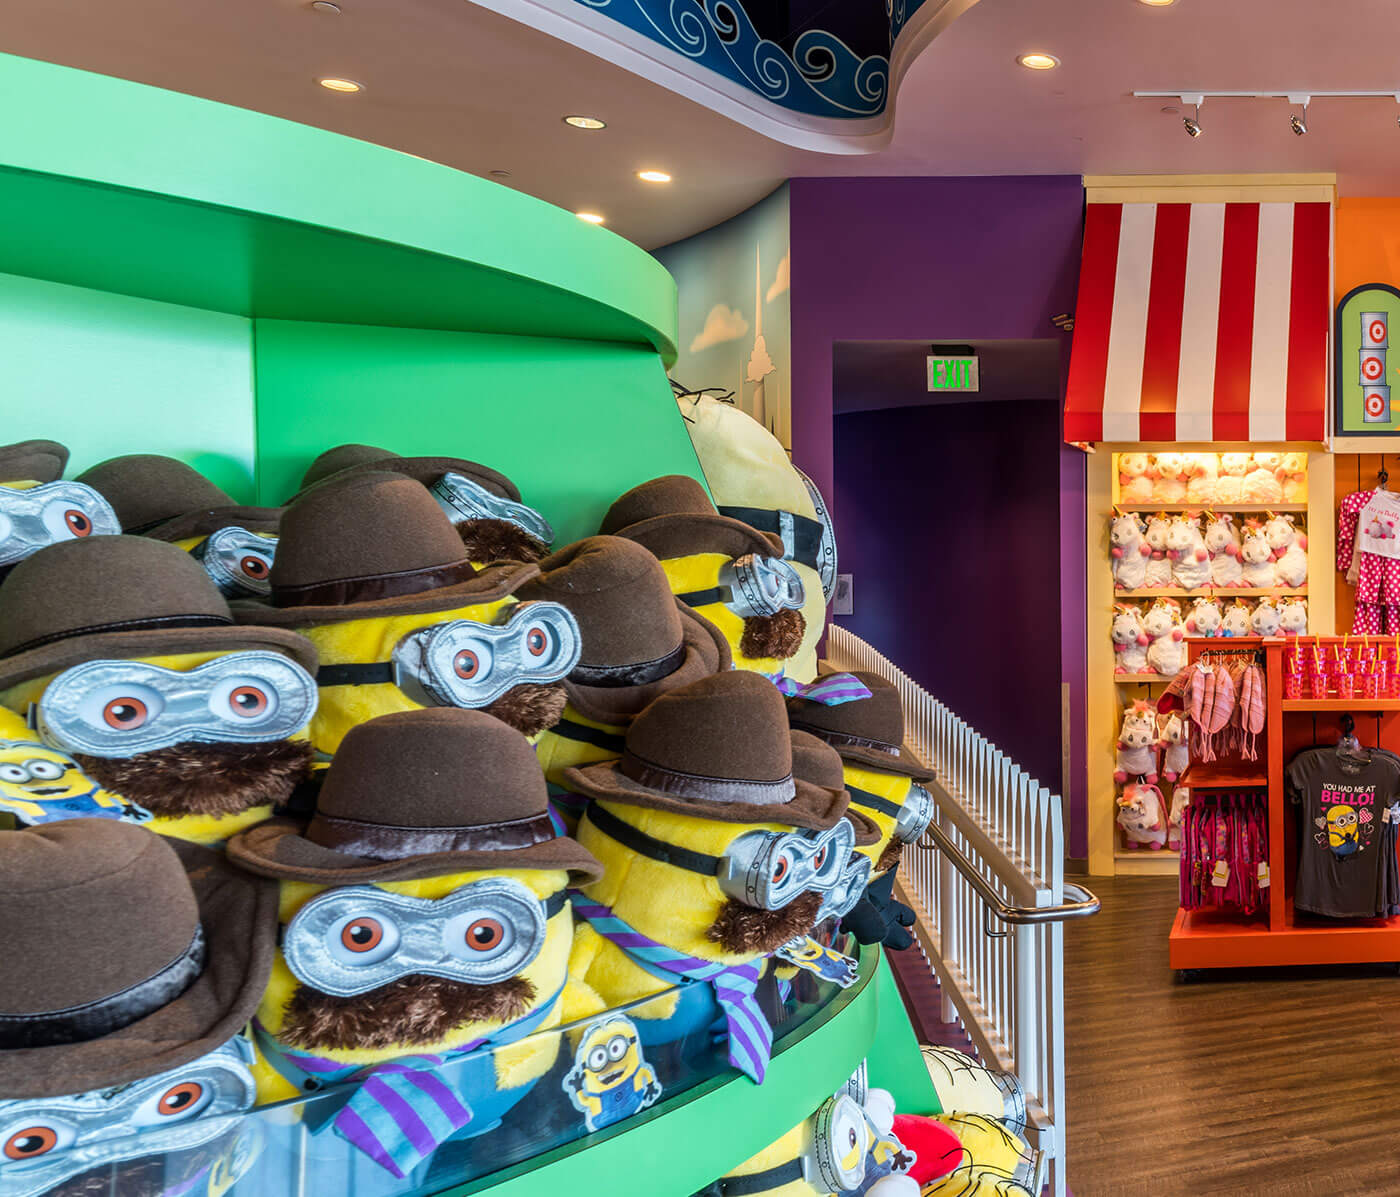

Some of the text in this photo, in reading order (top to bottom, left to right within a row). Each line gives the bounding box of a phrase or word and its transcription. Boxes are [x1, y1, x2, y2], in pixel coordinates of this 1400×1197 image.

[932, 359, 972, 388] EXIT
[1323, 783, 1337, 791] YOU
[1338, 785, 1353, 793] HAD
[1365, 785, 1376, 793] AT
[1321, 789, 1375, 806] BELLO!
